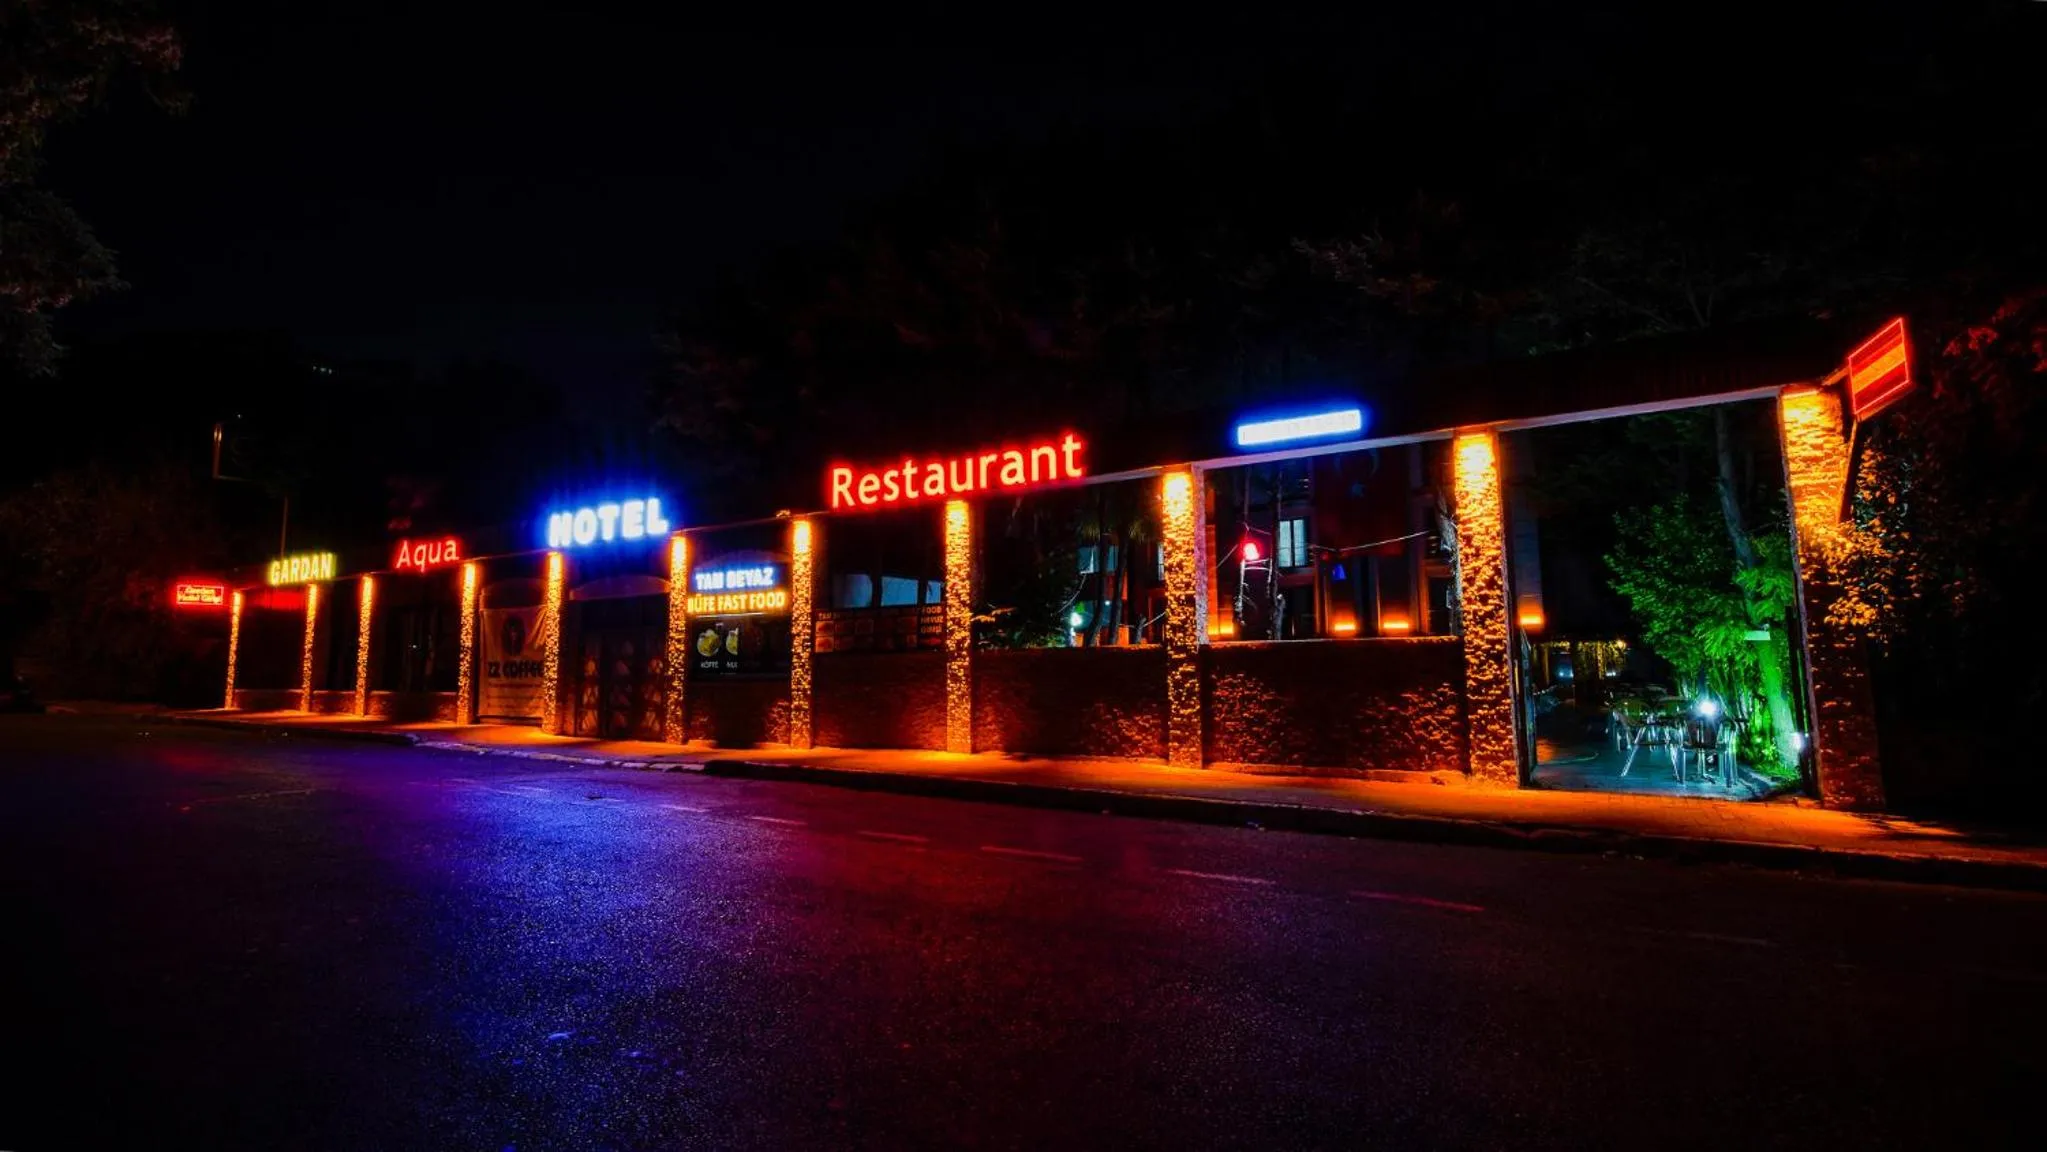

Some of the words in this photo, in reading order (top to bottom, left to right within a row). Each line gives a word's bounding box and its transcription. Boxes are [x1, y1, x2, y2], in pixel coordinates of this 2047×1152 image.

[830, 433, 1084, 508] Restaurant
[548, 497, 669, 548] HOTEL
[395, 539, 459, 573] Aqua
[717, 593, 748, 610] FAST
[750, 591, 785, 609] FOOD
